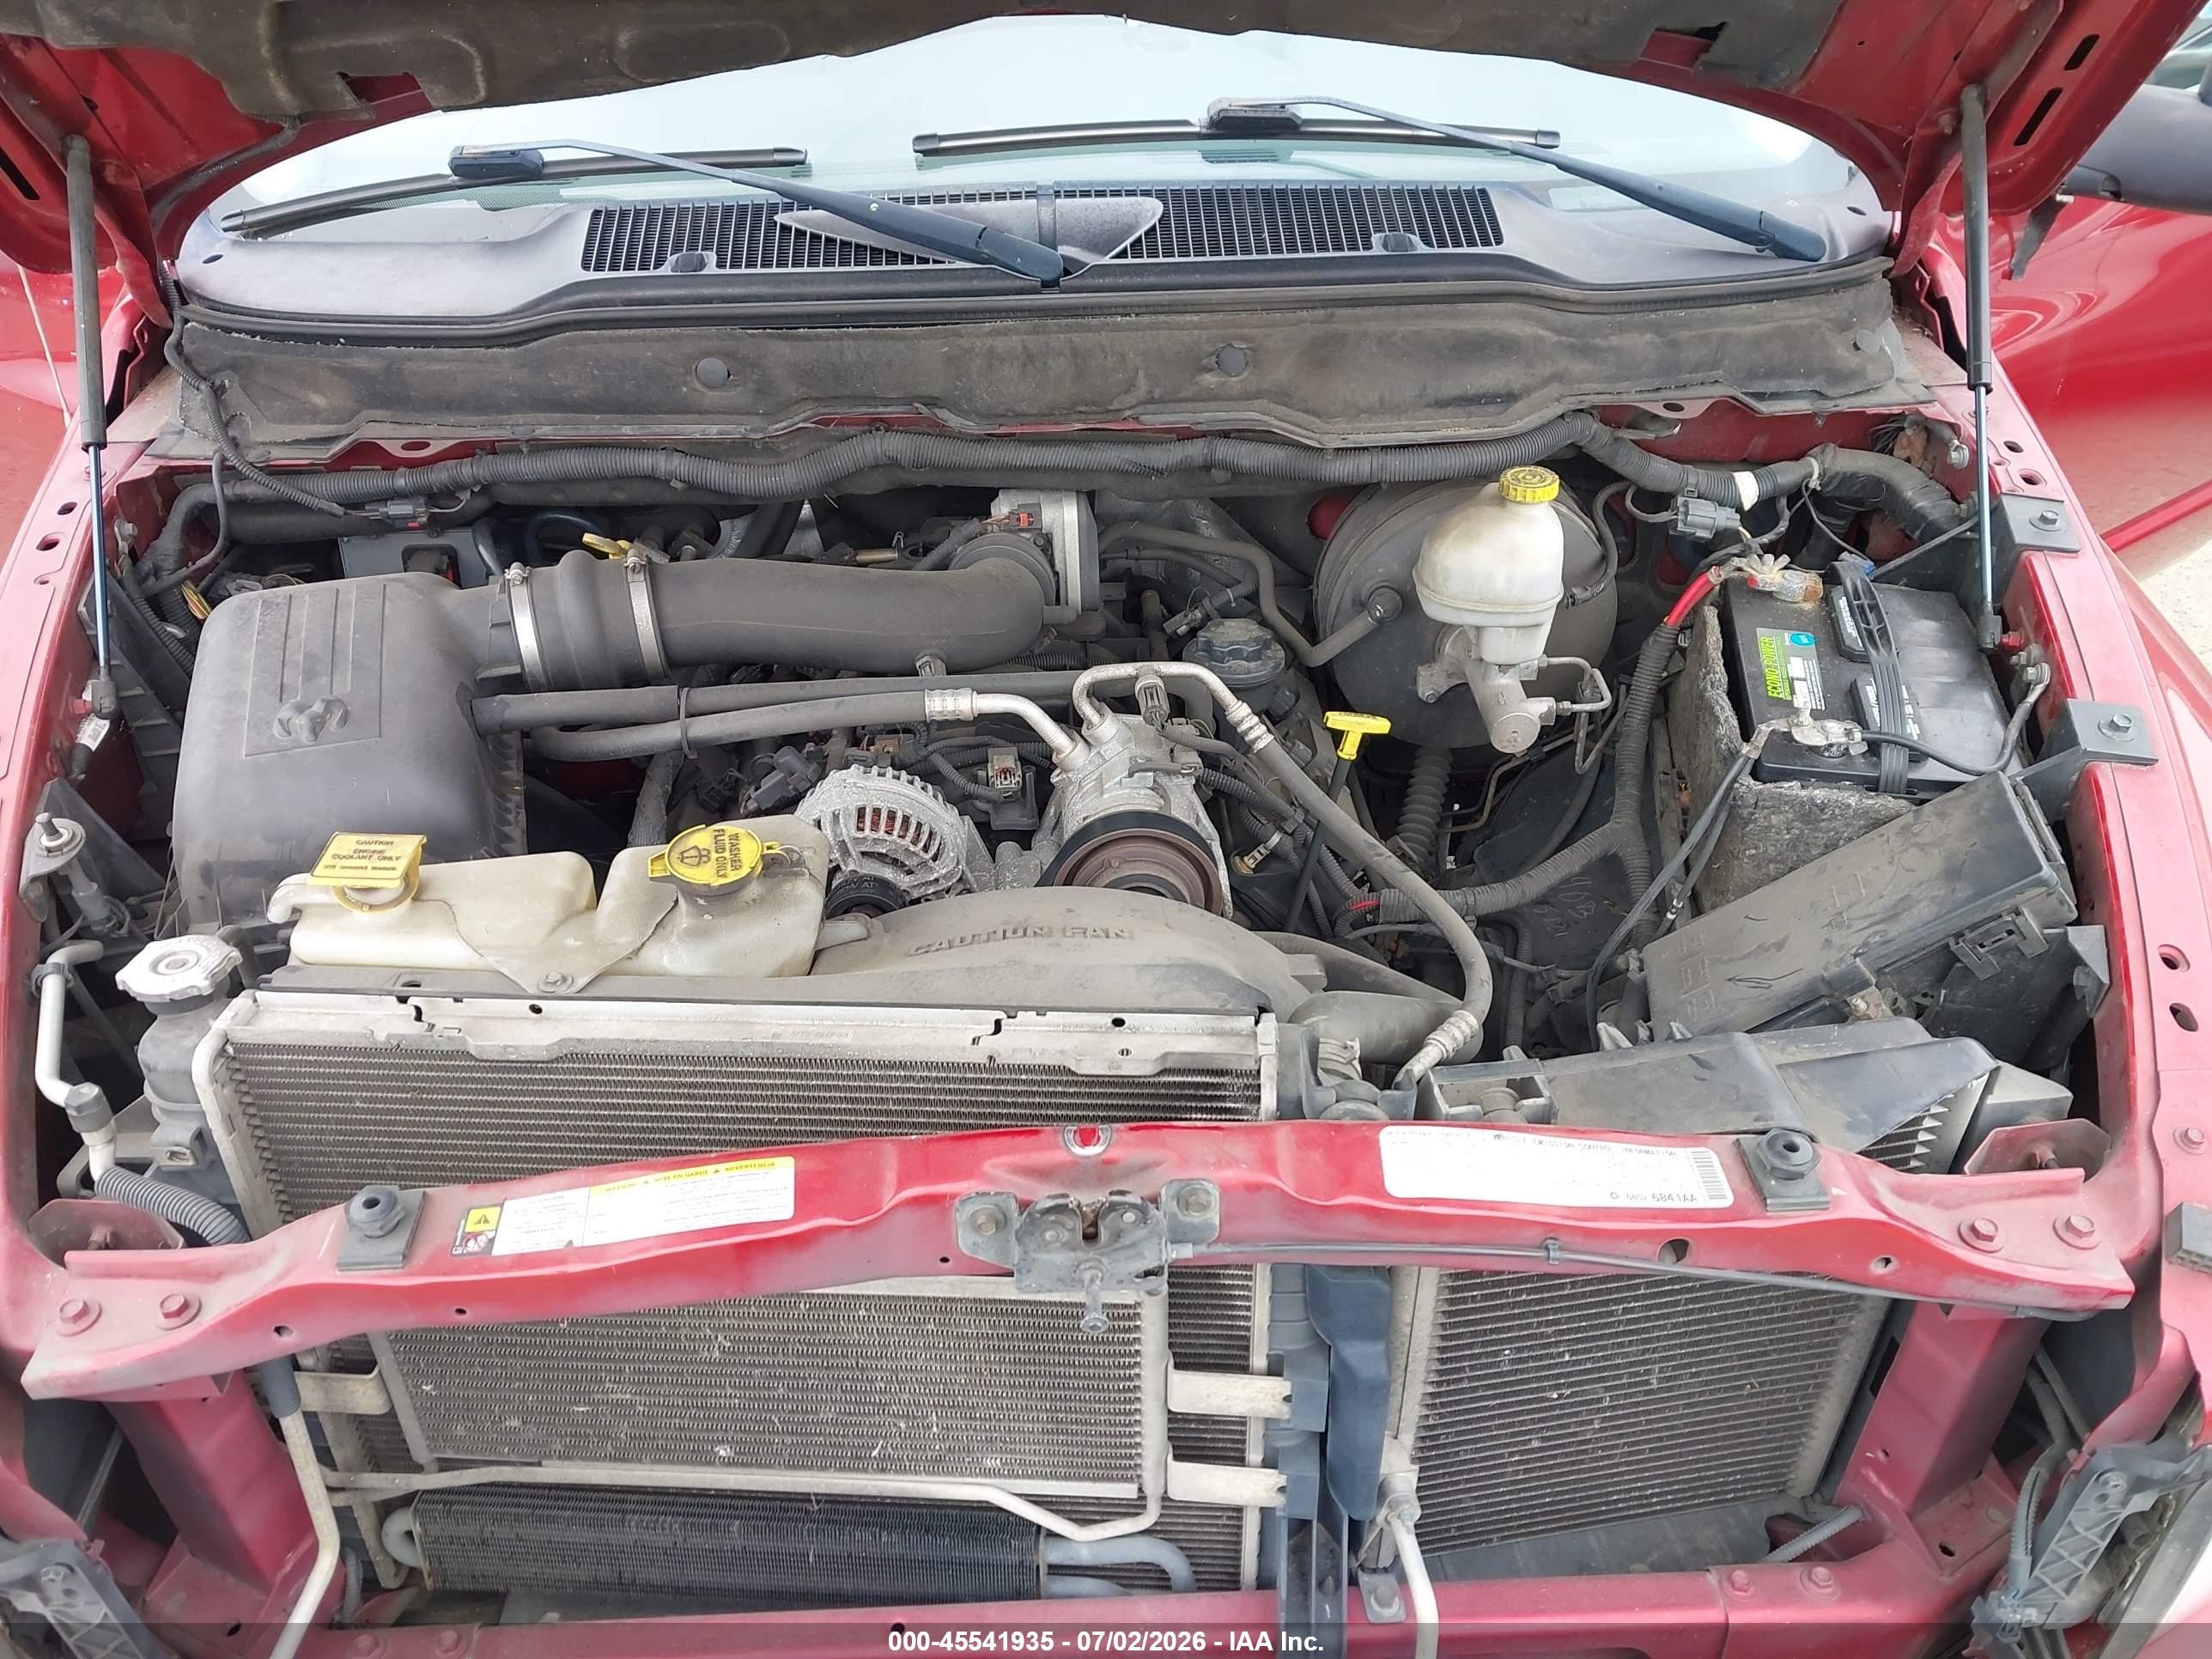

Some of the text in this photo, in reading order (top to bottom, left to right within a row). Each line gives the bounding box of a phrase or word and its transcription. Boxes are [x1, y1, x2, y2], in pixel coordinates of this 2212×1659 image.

[714, 829, 728, 878] FLUID ONLY
[728, 832, 742, 871] WASHER
[908, 924, 1135, 957] CAUTION FAN
